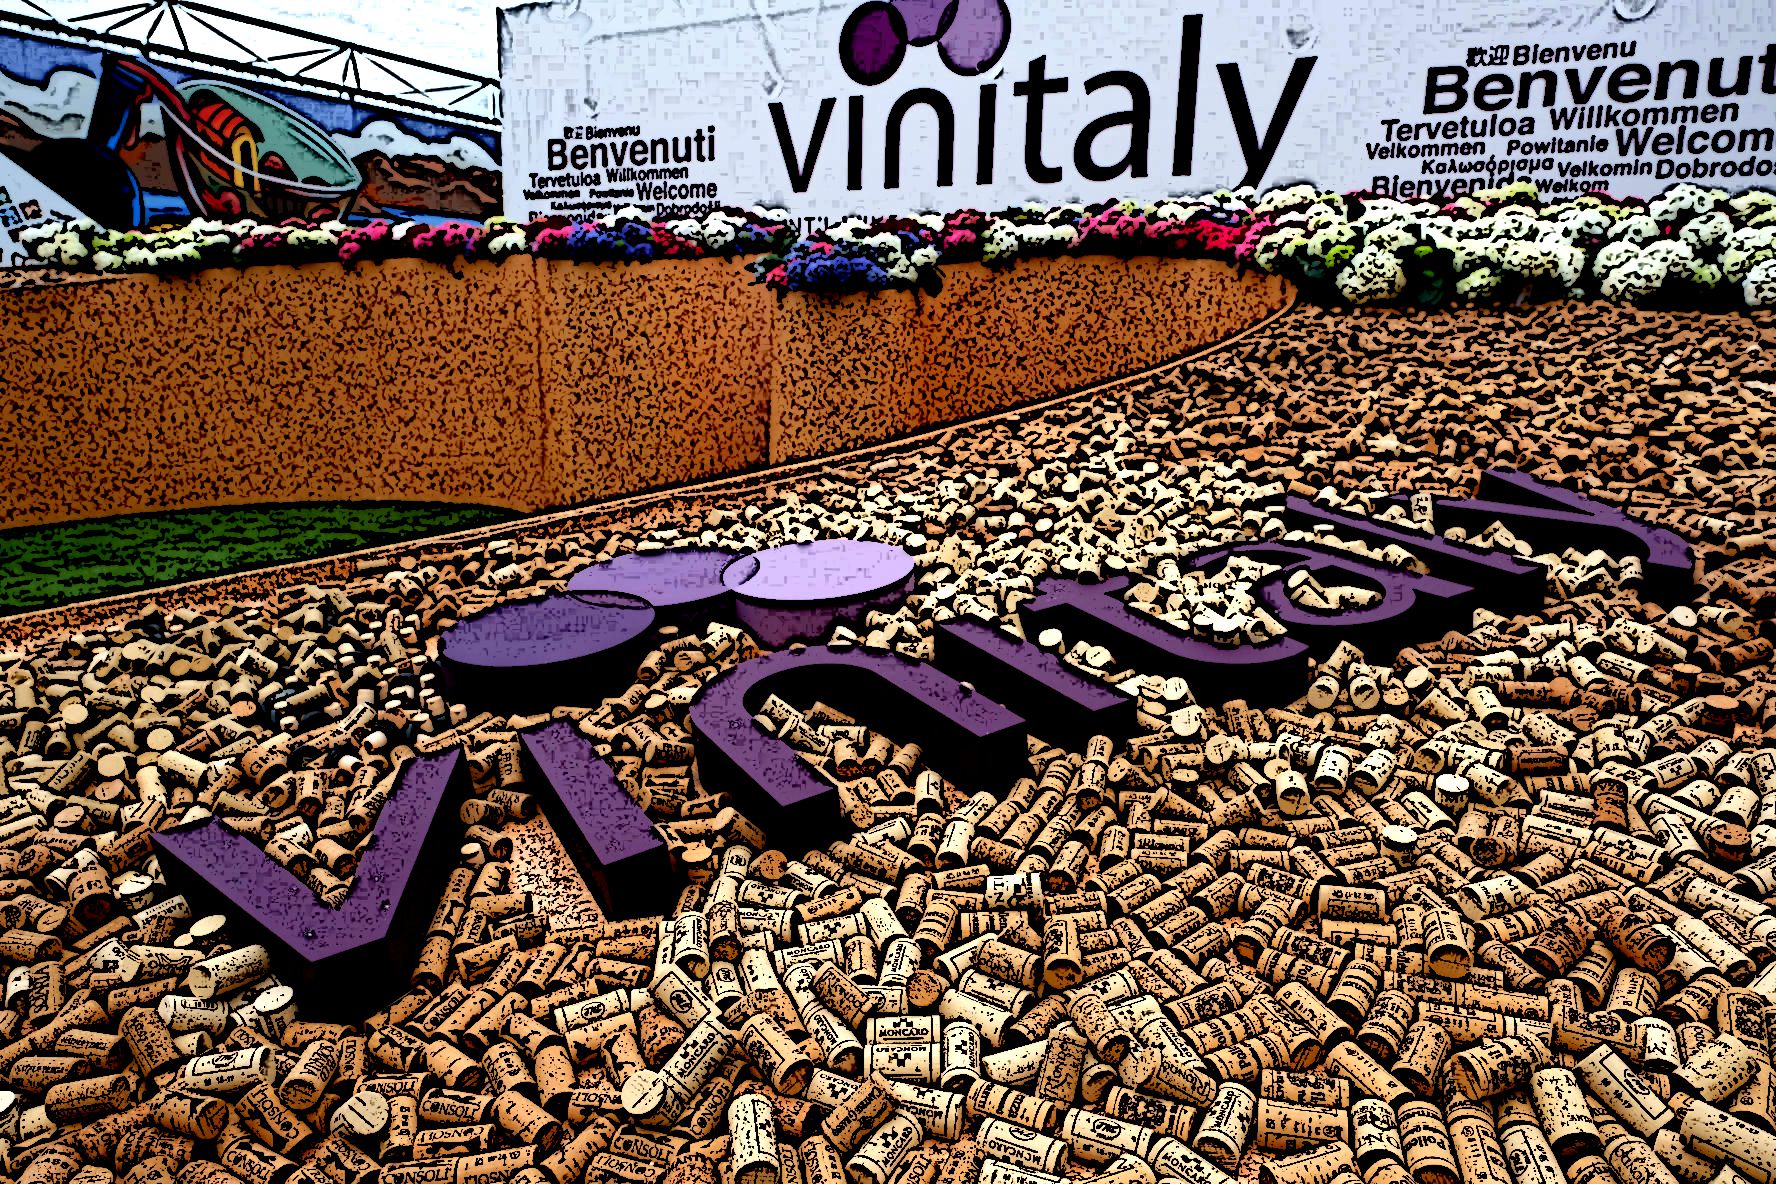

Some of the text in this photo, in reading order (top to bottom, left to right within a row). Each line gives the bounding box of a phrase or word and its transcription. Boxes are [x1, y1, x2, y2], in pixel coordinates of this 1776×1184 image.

[1513, 41, 1637, 66] Bienvenu
[768, 13, 1318, 193] vinitaly
[1381, 103, 1740, 142] Tervetuloa Willkommen
[548, 125, 716, 171] Benvenuti
[1366, 141, 1486, 160] Velkommen
[1507, 134, 1609, 156] Powitanie
[529, 166, 689, 189] Tervetuloa Willkommen
[1558, 156, 1776, 180] Velkomin Dobrodo
[636, 181, 718, 201] Welcome
[1534, 178, 1610, 194] Welkom
[150, 470, 1697, 965] vinitaly
[878, 1027, 930, 1038] MONCARO
[676, 1032, 717, 1078] MONCARO
[422, 1099, 480, 1120] CONSOLI
[613, 1136, 671, 1161] CONSOLI
